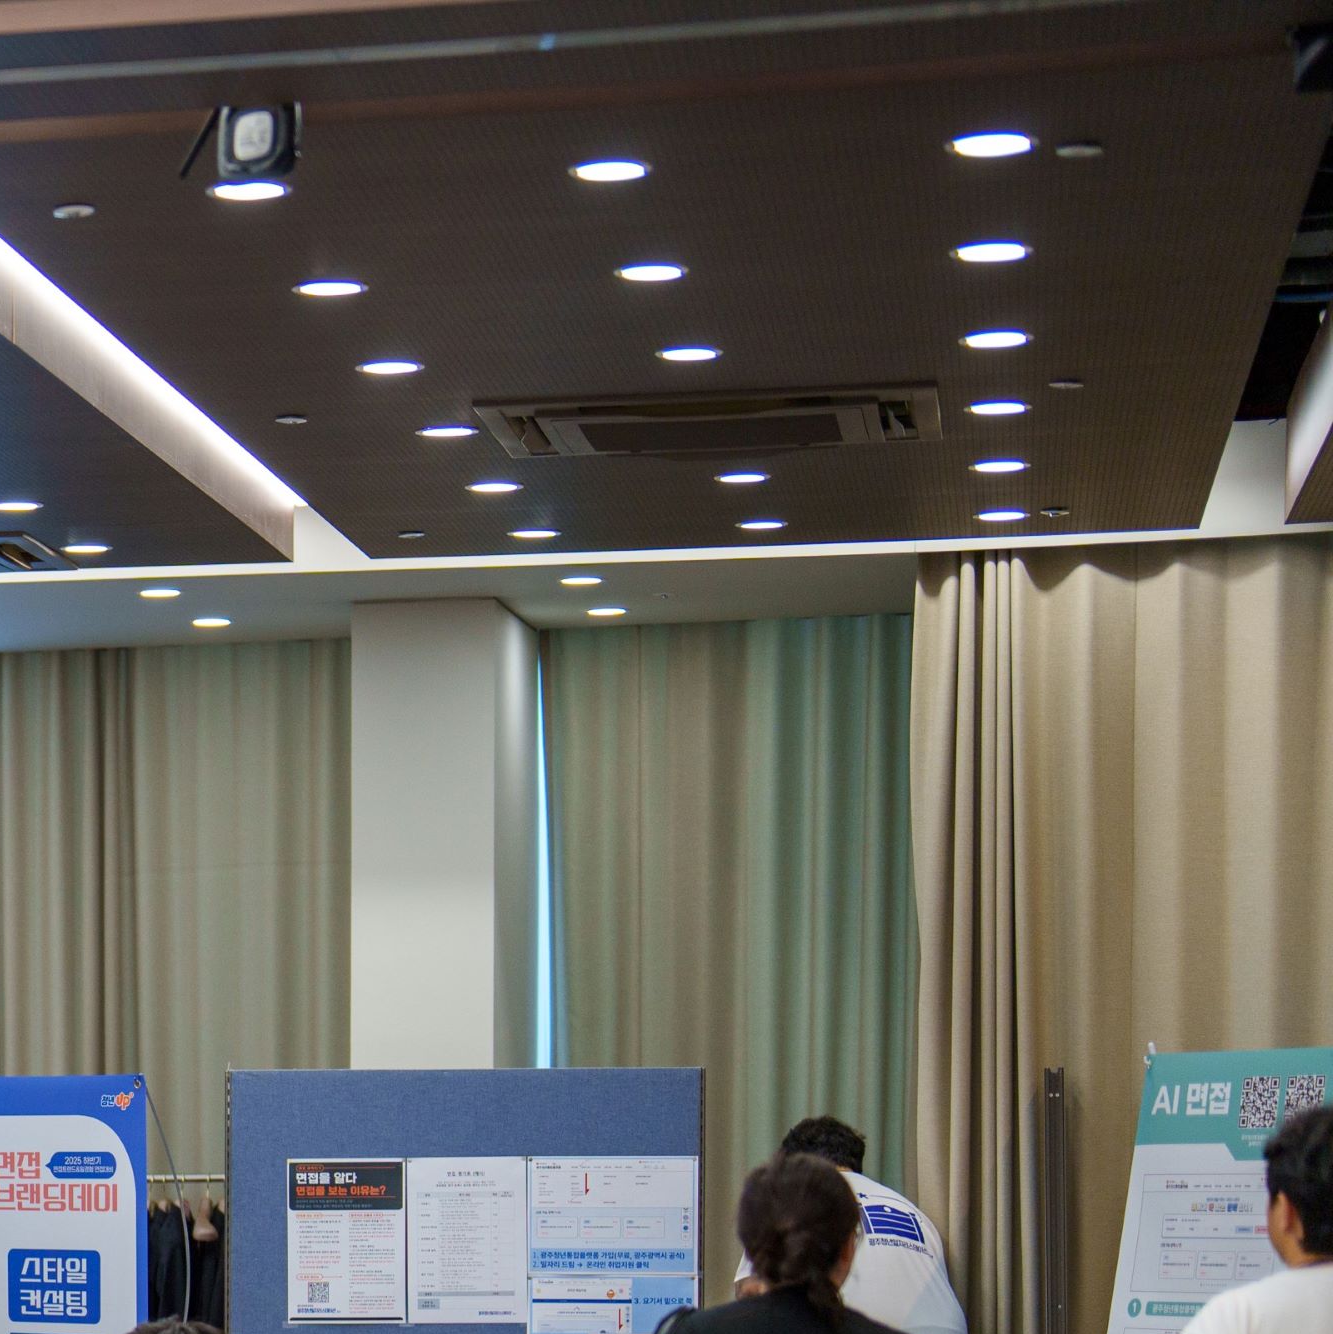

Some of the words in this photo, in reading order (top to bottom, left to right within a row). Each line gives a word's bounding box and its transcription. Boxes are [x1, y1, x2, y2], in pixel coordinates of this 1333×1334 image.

[1151, 1084, 1181, 1116] AI
[1185, 1081, 1232, 1116] 면접
[64, 1156, 82, 1165] 2025
[83, 1156, 102, 1165] 하반기
[295, 1171, 331, 1185] 면접을
[333, 1171, 358, 1185] 알다
[295, 1185, 326, 1197] 면접을
[350, 1185, 387, 1197] 이유는?
[19, 1256, 88, 1286] 스타일
[540, 1260, 561, 1269] 일자리
[586, 1260, 606, 1269] 온라인
[19, 1288, 88, 1318] 컨설팅
